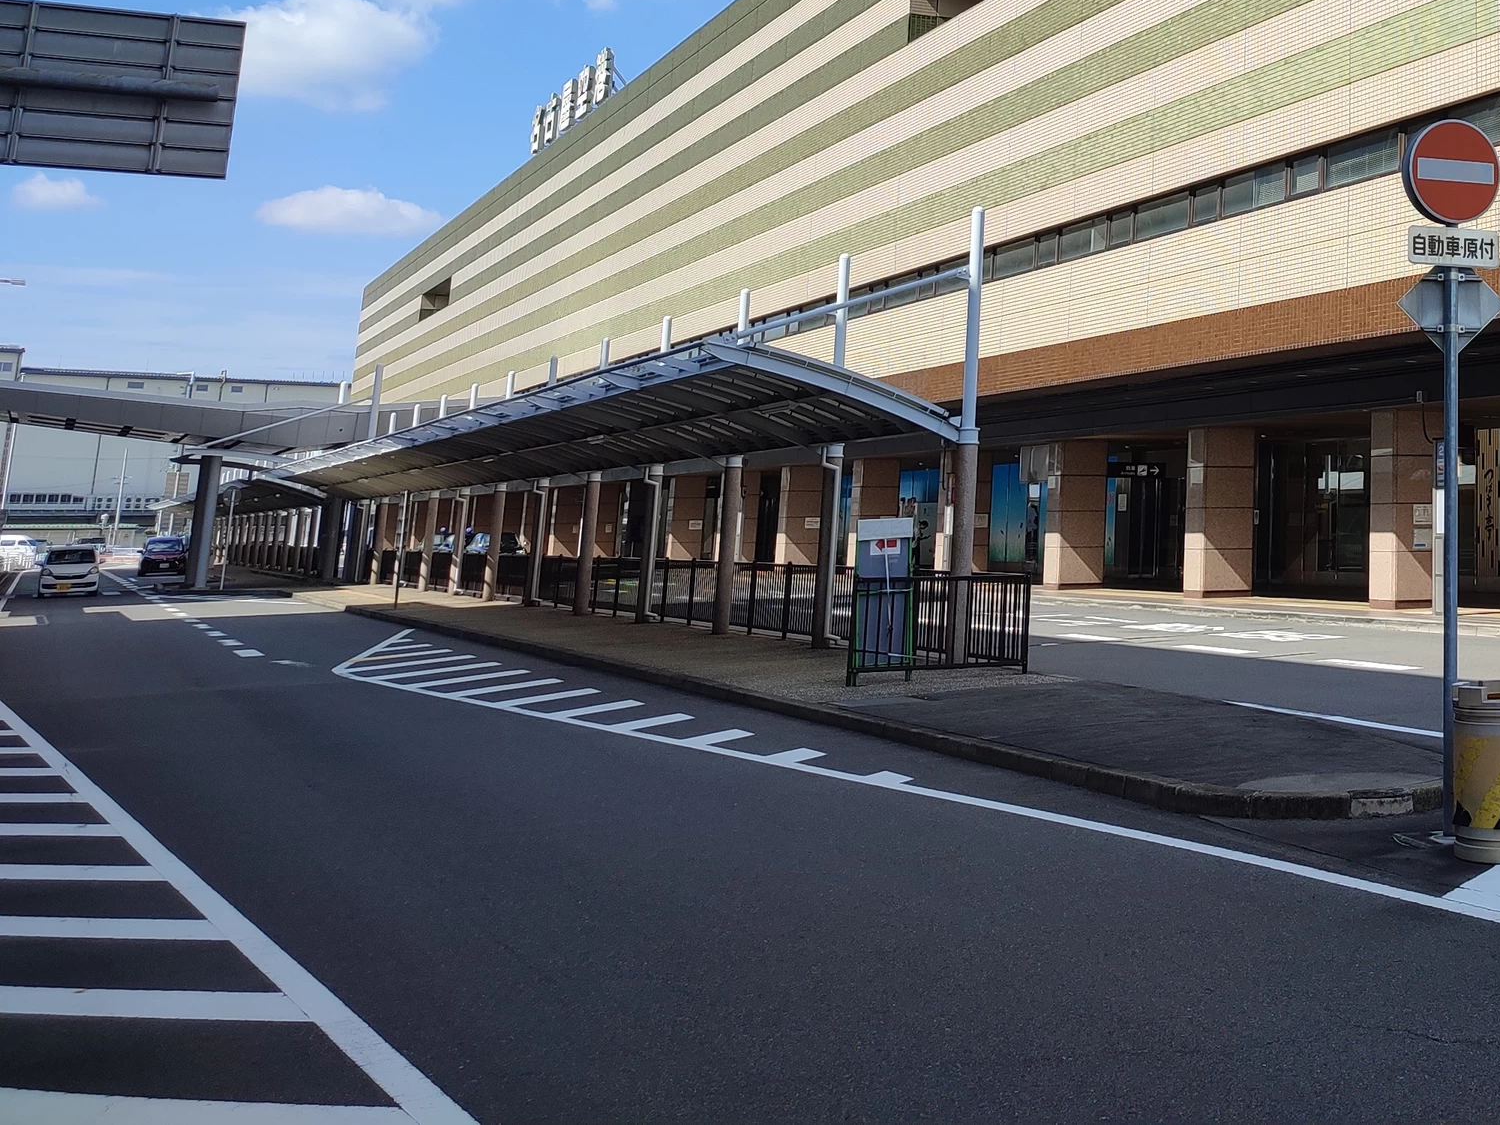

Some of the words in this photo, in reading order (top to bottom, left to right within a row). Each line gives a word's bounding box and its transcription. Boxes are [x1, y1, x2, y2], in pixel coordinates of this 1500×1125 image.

[530, 46, 614, 155] 名古屋空港
[1412, 233, 1496, 261] 自動車・原付
